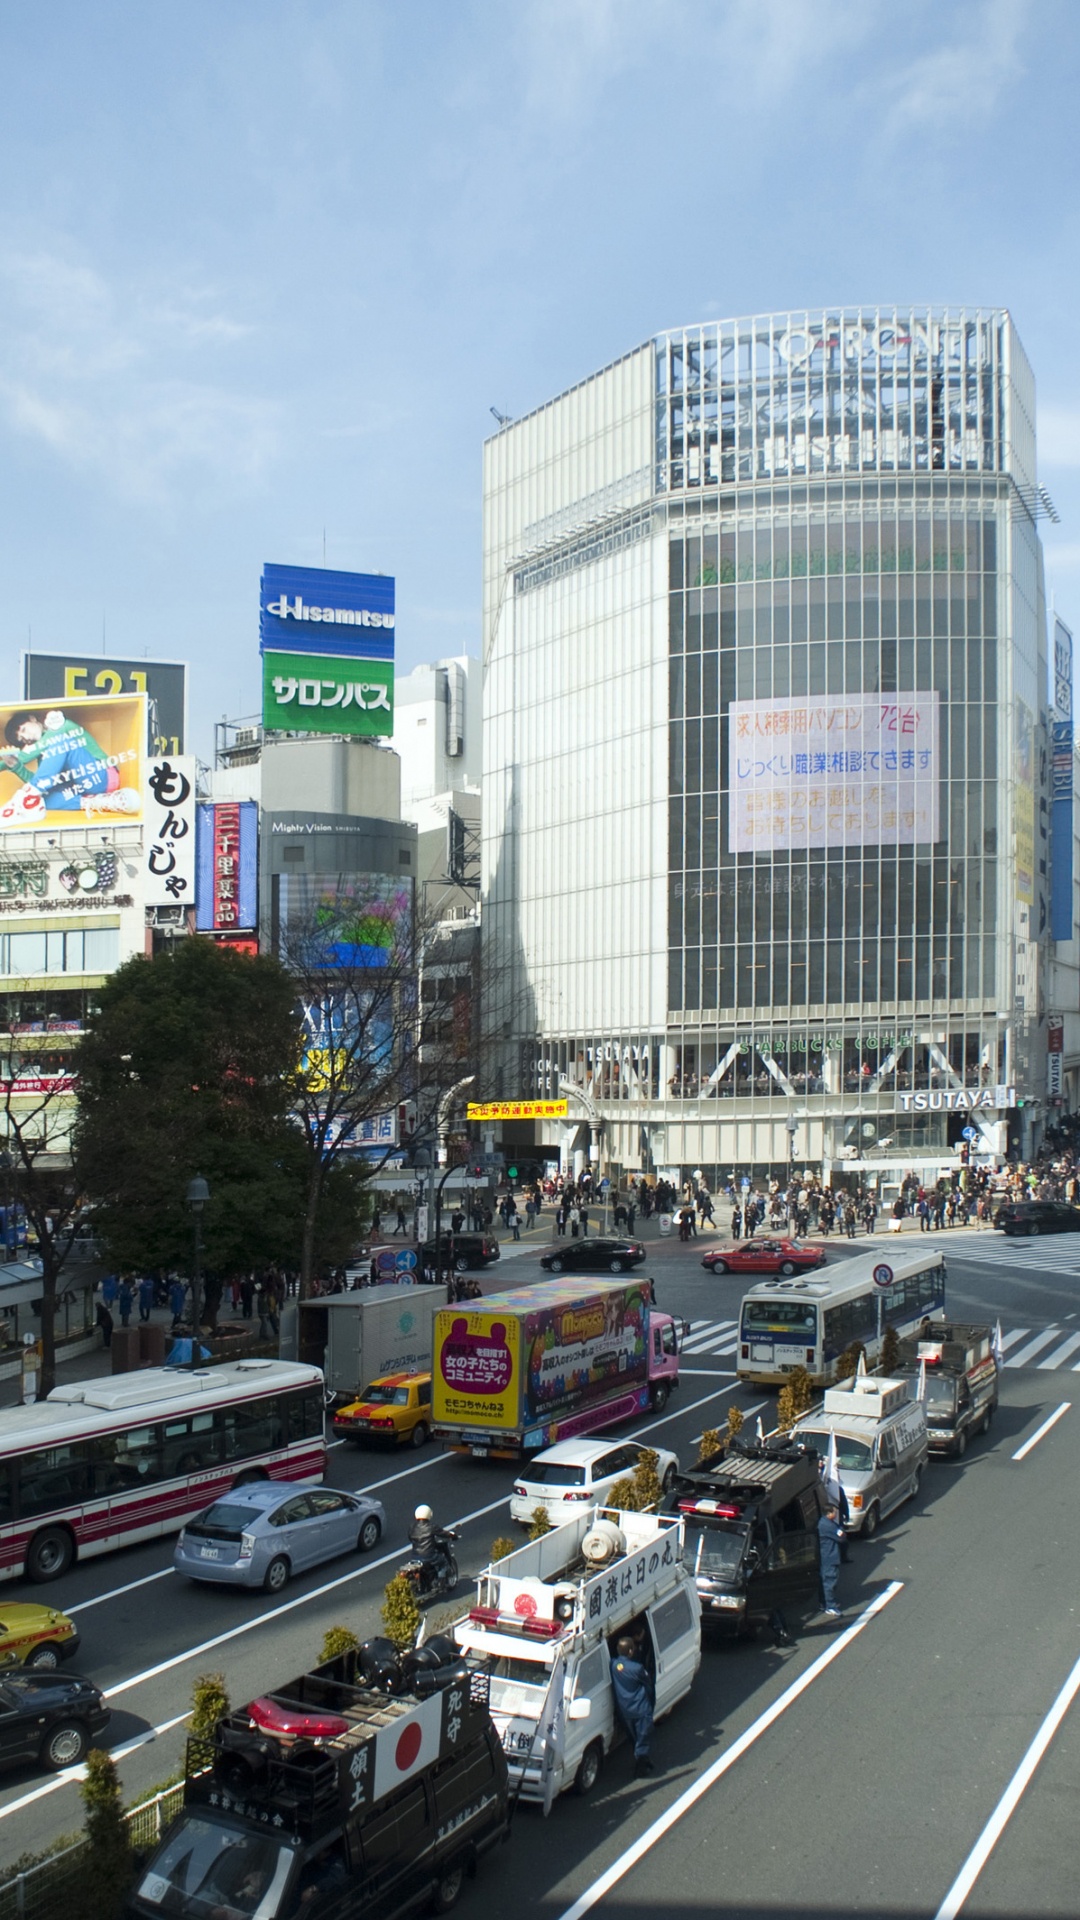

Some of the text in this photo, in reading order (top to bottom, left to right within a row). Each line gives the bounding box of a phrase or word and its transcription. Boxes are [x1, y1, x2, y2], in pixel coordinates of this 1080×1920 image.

[267, 595, 395, 629] Hisamitsu
[272, 676, 390, 711] サロンパス
[36, 727, 84, 749] KAWARU
[41, 737, 87, 760] XYLISH
[50, 749, 137, 786] XYLISHOES
[148, 761, 190, 899] もんじゃ
[272, 822, 304, 833] Mighty
[306, 823, 332, 833] Vision
[214, 807, 236, 922] 三千里薬品
[587, 1044, 649, 1062] TSUTAYA
[739, 1036, 843, 1055] STARBUCKS
[1051, 1053, 1060, 1095] TSUTAYA
[900, 1090, 994, 1111] TSUTAYA
[445, 1355, 507, 1371] 女の子たちの
[445, 1398, 504, 1412] モモコちゃんねる
